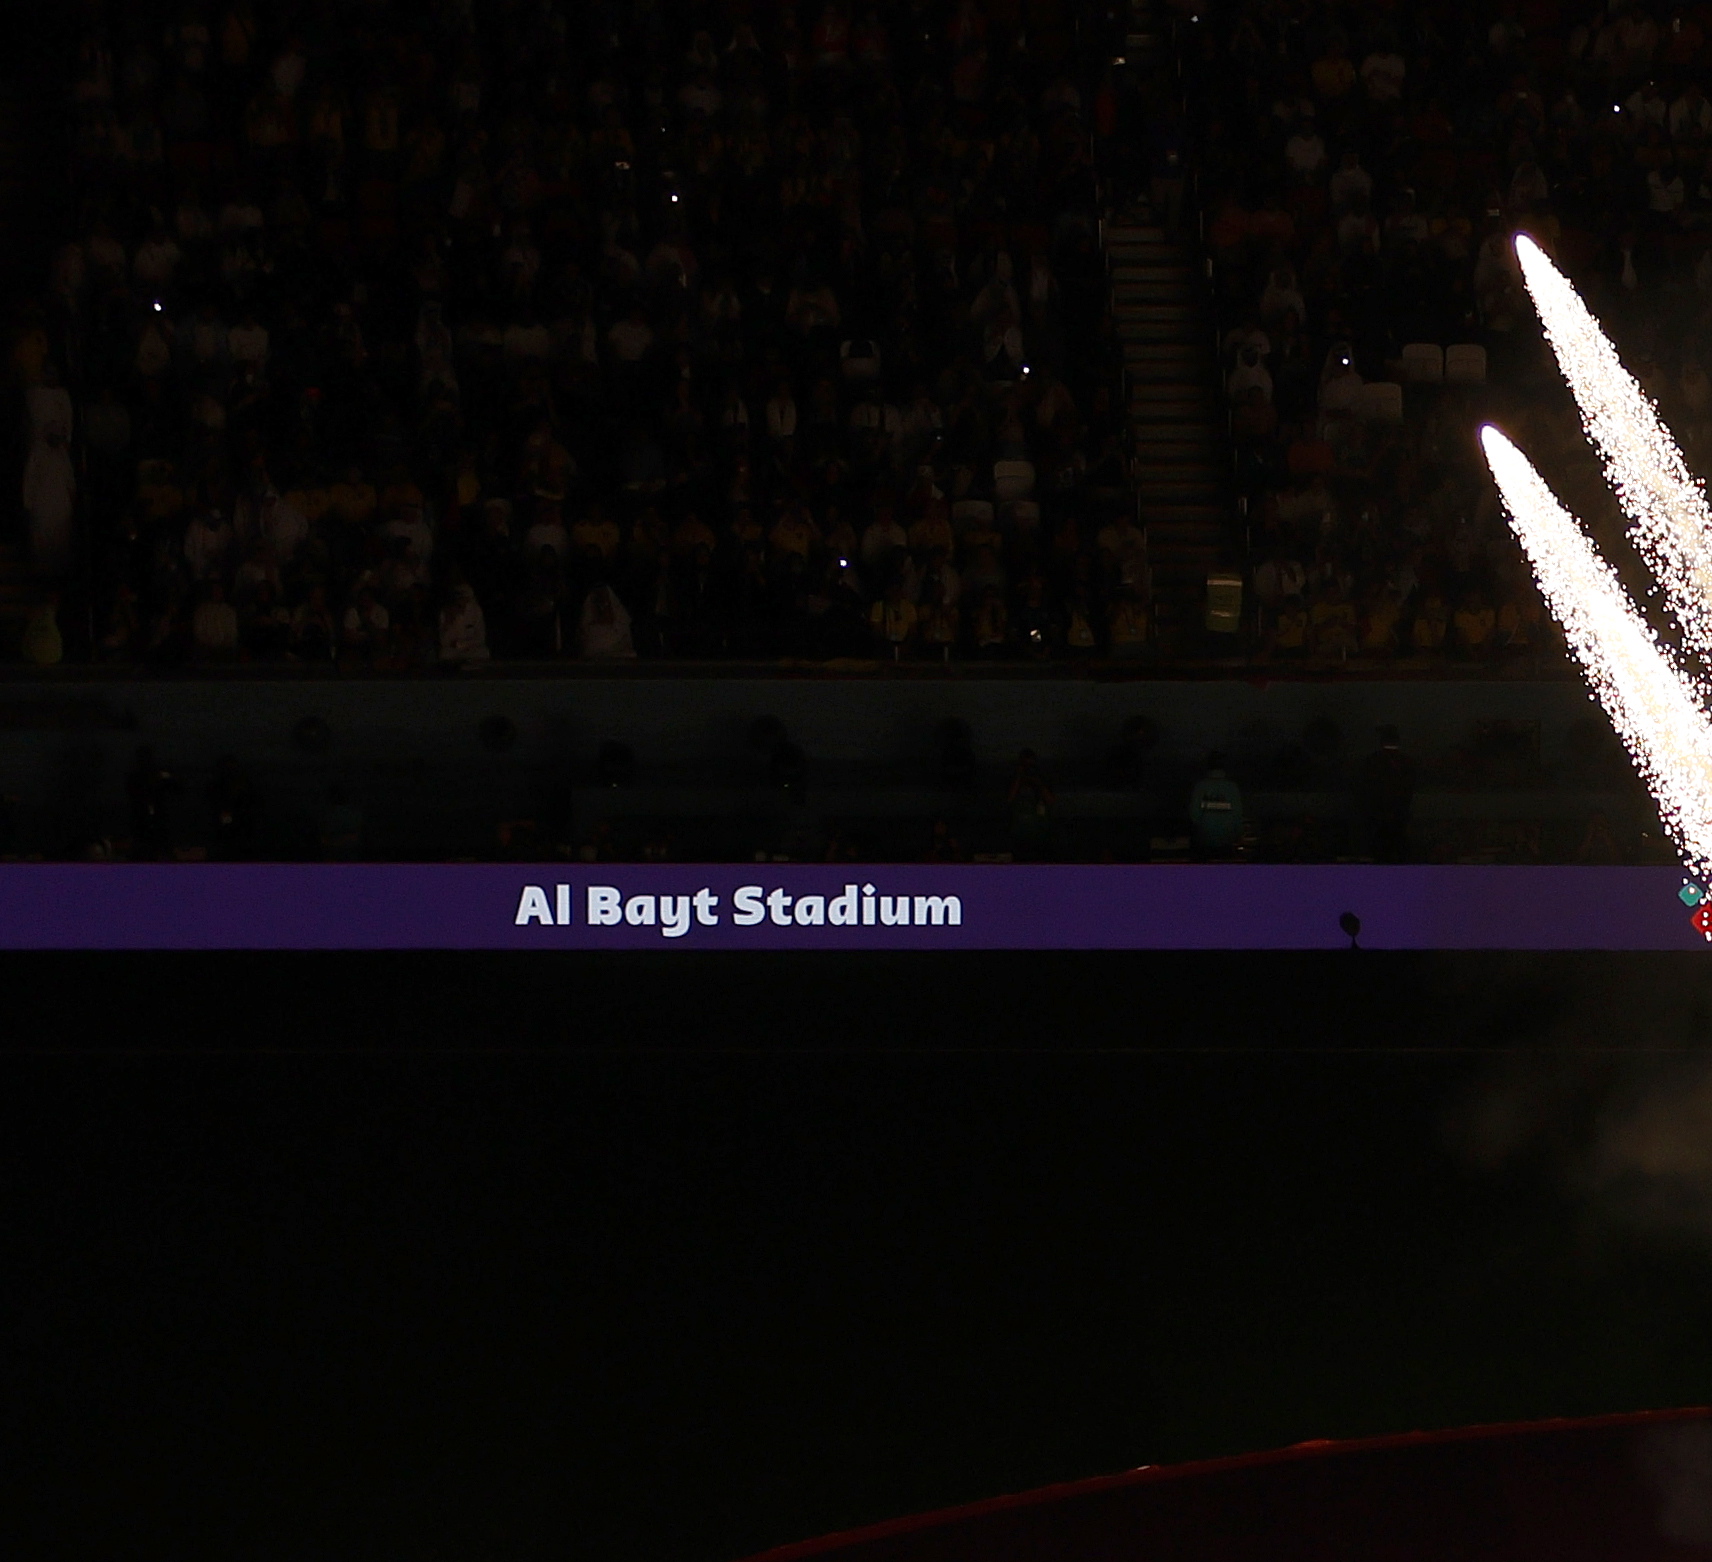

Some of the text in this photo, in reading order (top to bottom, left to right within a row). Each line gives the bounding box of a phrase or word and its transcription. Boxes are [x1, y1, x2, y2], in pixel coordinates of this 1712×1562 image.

[514, 883, 962, 938] Al Bayt Stadium
